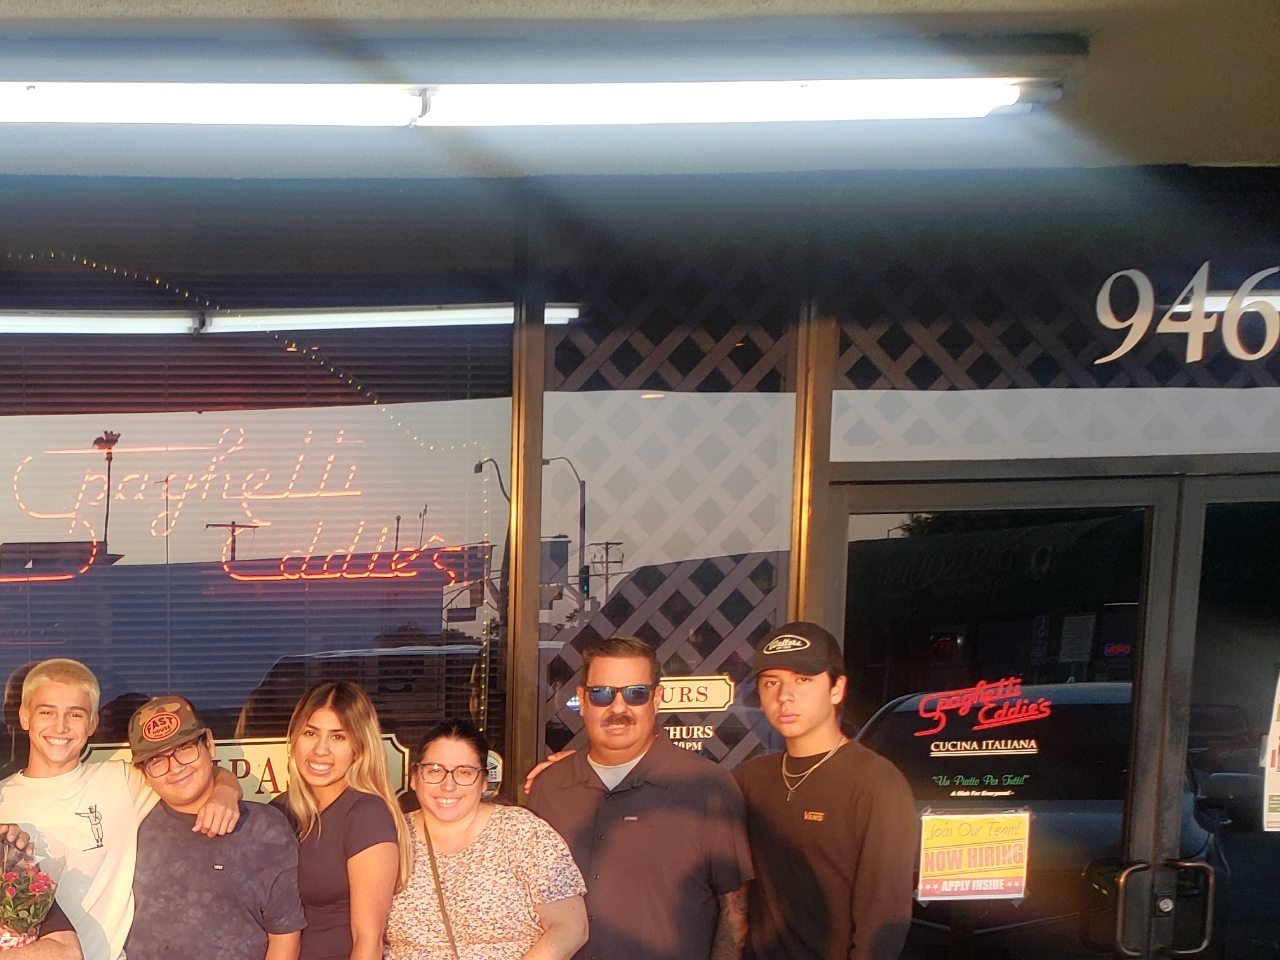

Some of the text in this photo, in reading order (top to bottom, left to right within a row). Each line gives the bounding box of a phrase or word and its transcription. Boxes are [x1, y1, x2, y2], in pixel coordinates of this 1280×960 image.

[1094, 259, 1280, 364] 946
[913, 675, 1023, 737] Spaghetti
[972, 697, 1052, 731] Eddie's
[146, 716, 174, 735] FAST
[930, 738, 1038, 752] CUCINA ITALIANA
[953, 774, 980, 786] Piatto
[982, 774, 999, 786] Per
[804, 811, 825, 822] VANS
[926, 821, 1022, 840] Join Our Team!
[924, 842, 1024, 873] NOW HIRING
[941, 878, 1005, 892] APPLY INSIDE
